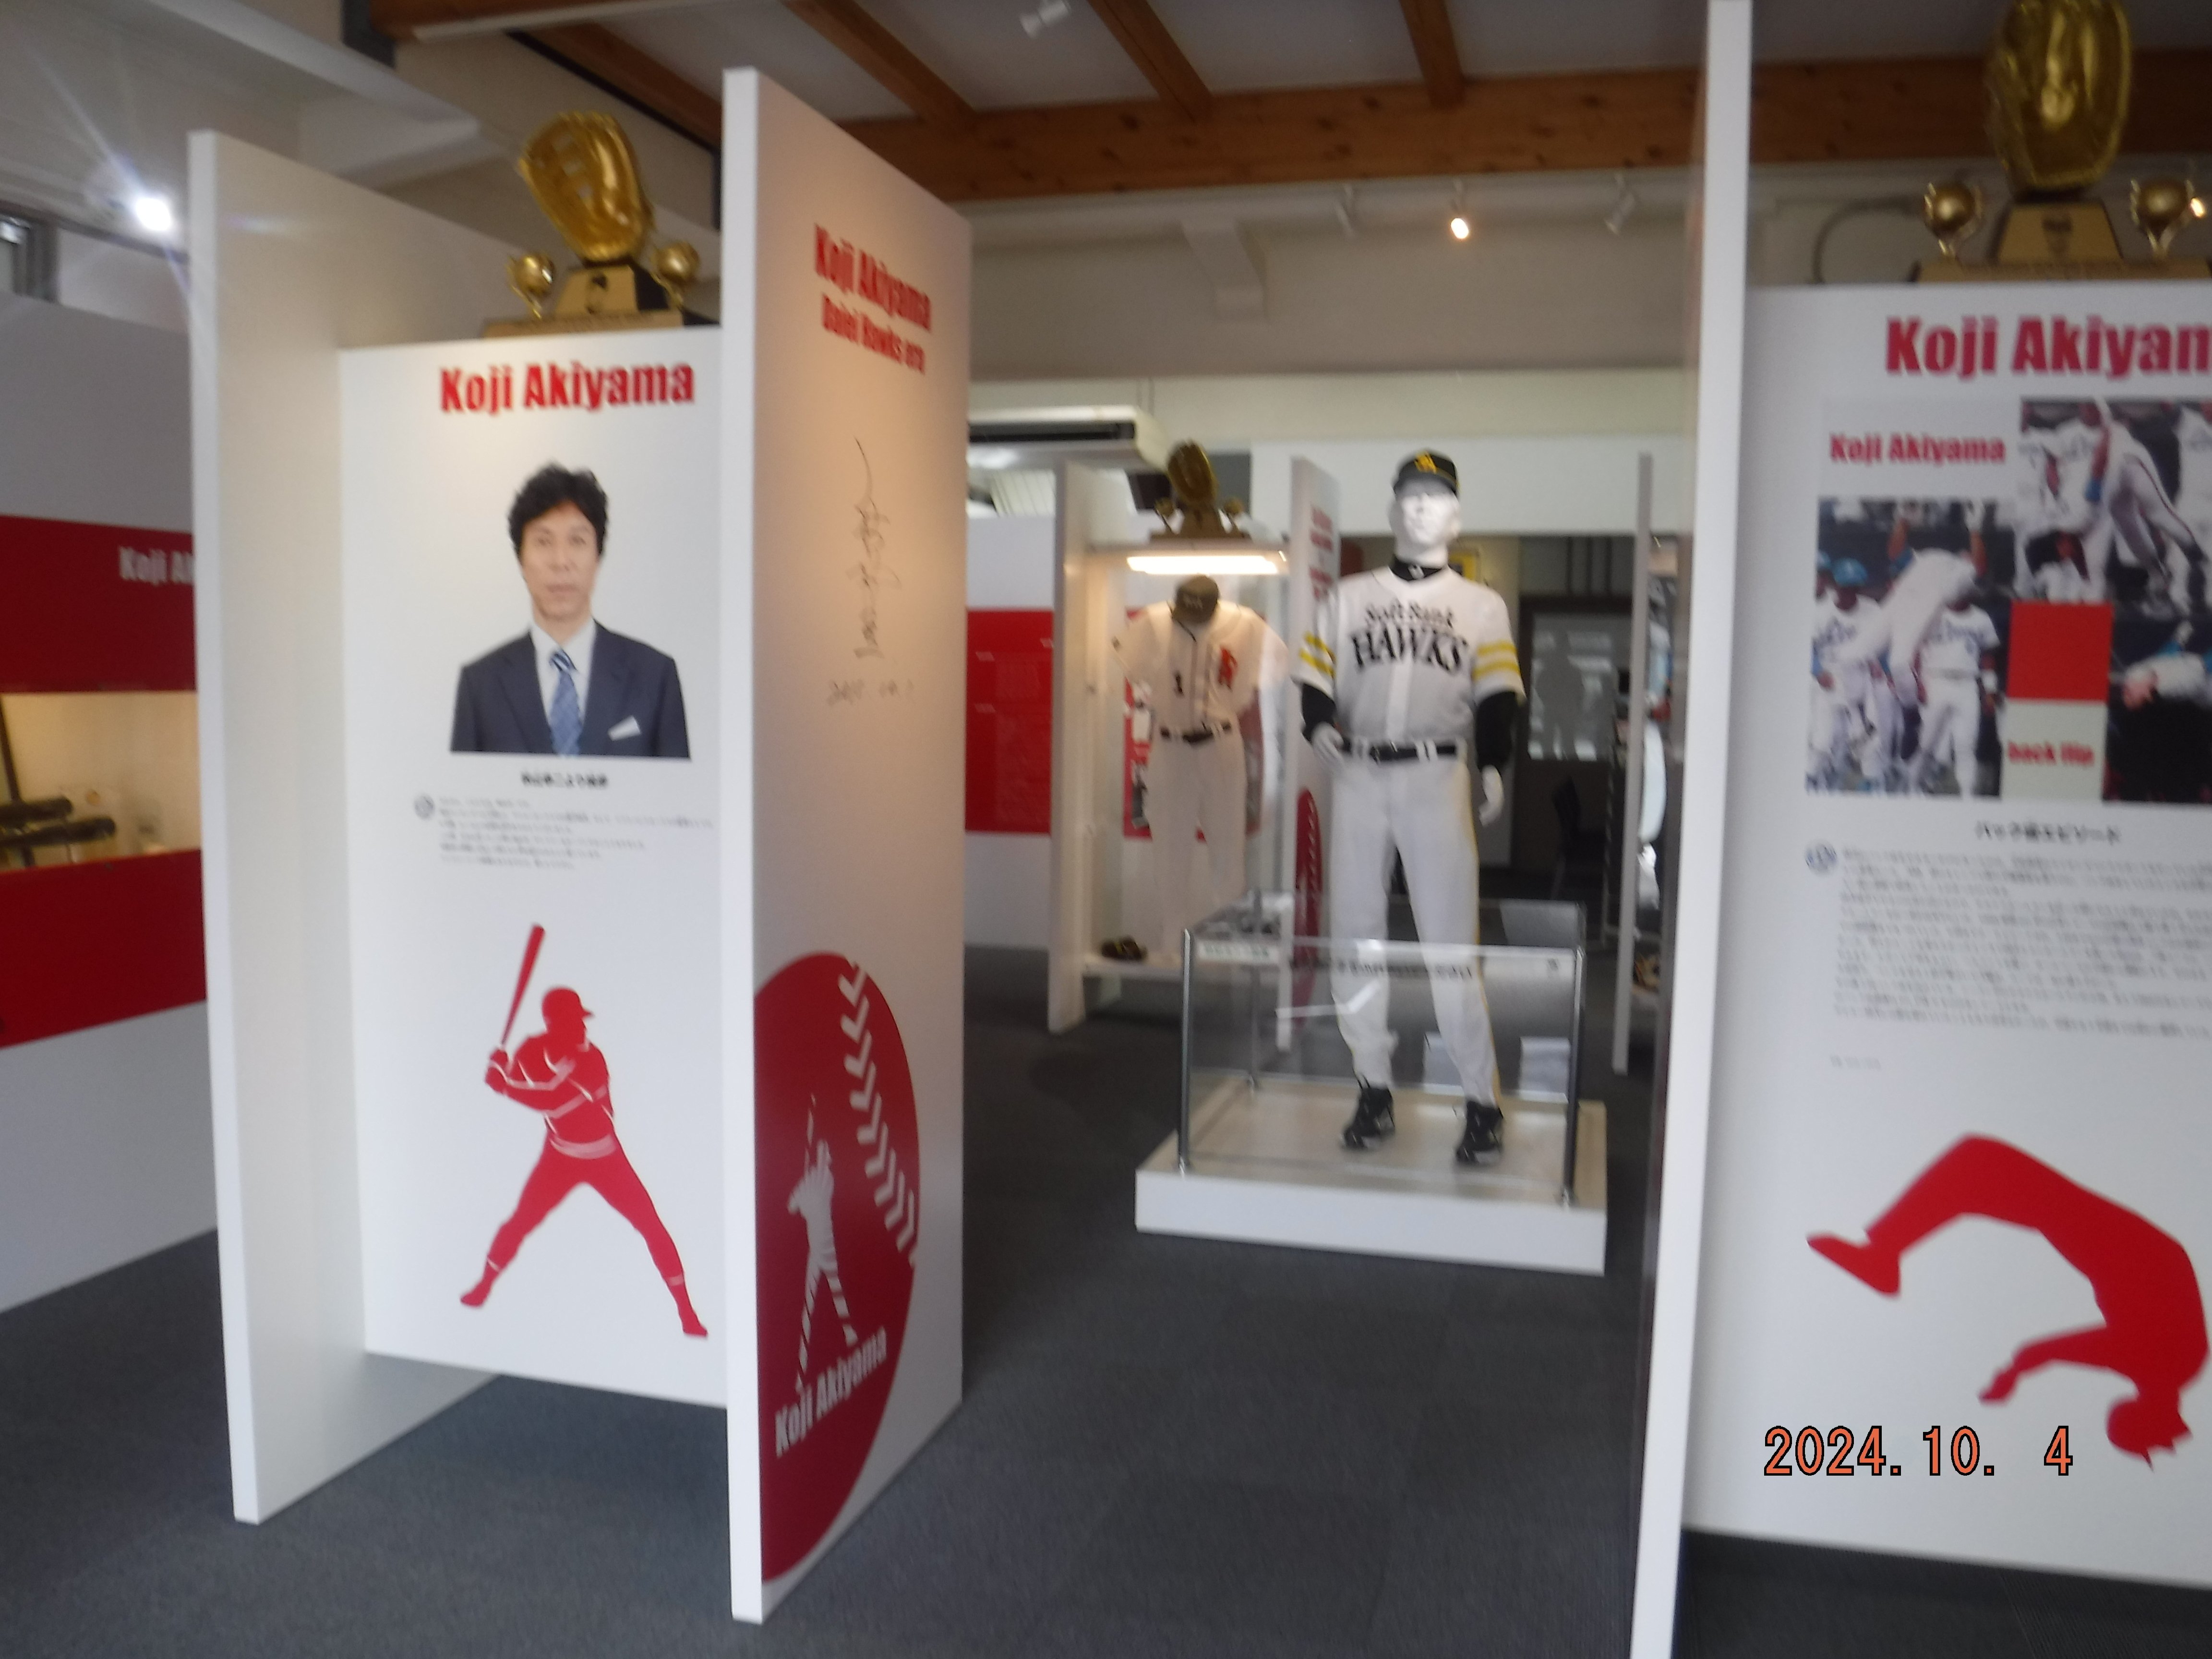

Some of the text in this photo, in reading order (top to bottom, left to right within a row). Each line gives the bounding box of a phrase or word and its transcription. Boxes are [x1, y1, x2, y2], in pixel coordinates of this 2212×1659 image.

[815, 223, 931, 331] Koji Akiyama
[1887, 315, 1999, 380] Koji
[440, 360, 695, 417] Koji Akiyama
[1829, 431, 2006, 465] Koji Akiyama
[1351, 627, 1469, 669] HAWKS
[775, 1326, 887, 1458] Koji Akiyama
